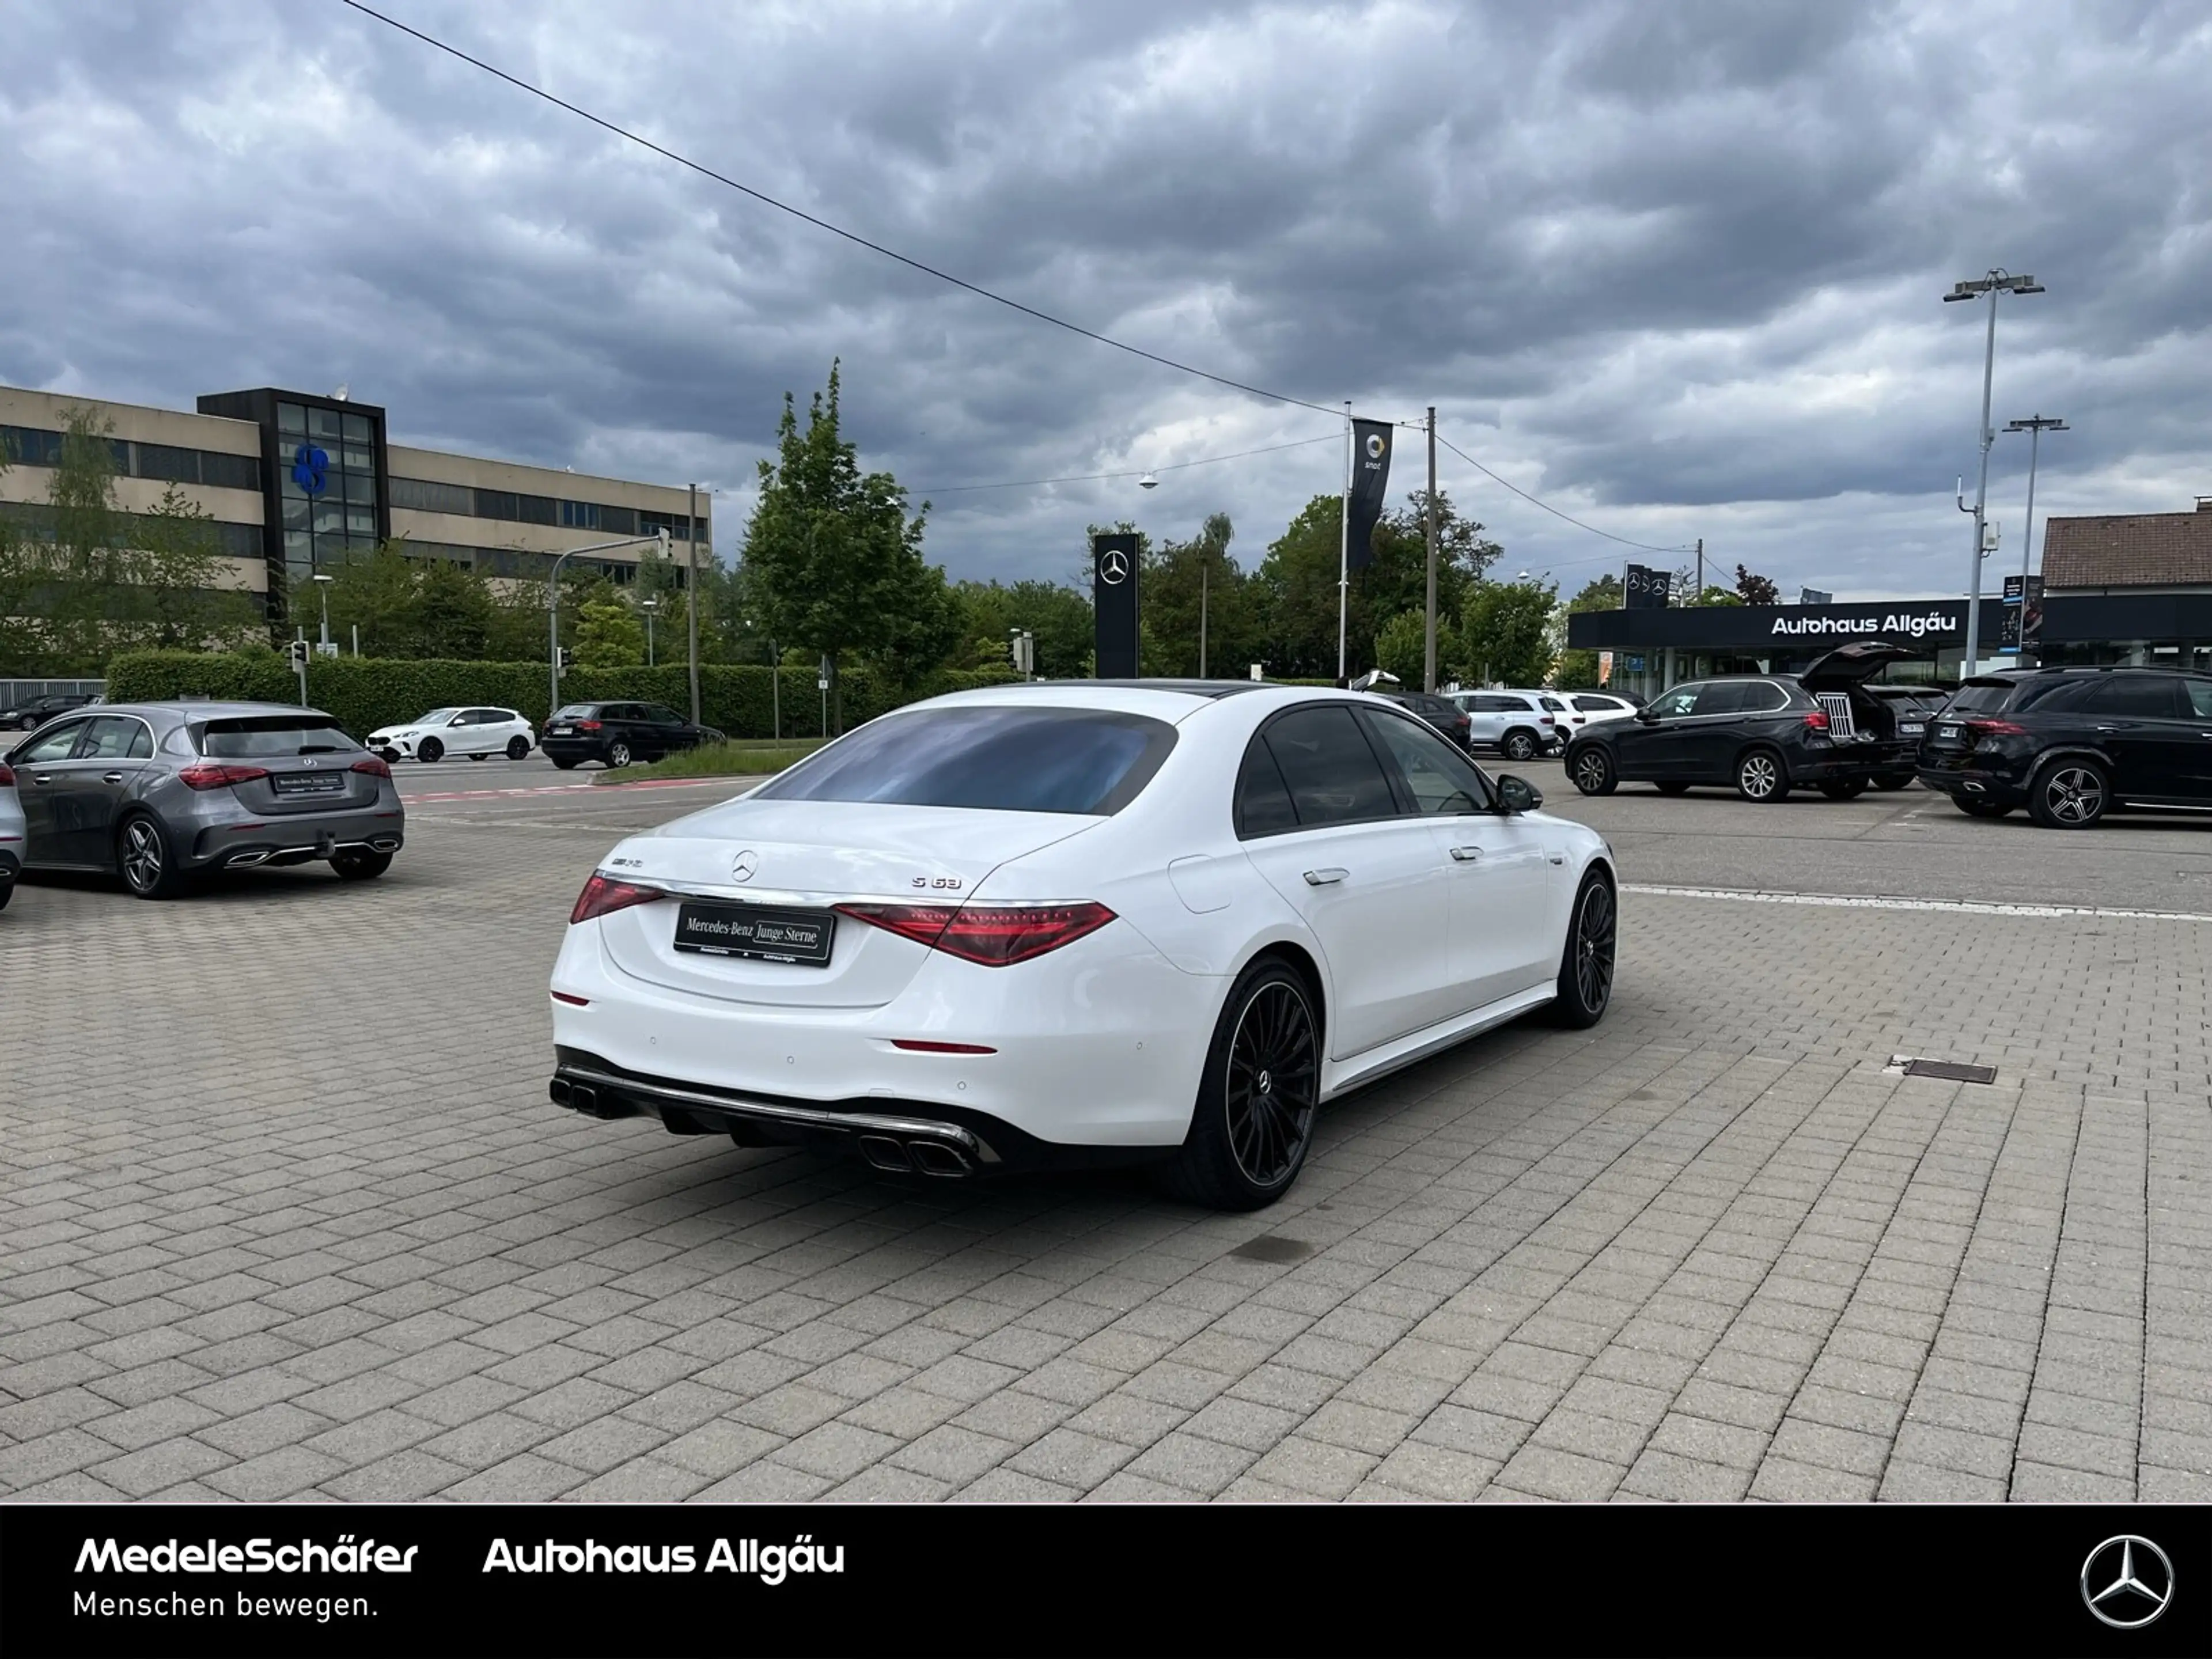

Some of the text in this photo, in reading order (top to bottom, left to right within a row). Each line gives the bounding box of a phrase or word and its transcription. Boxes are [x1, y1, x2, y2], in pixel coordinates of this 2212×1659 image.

[1771, 612, 1956, 637] Autohaus Allgäu
[912, 877, 961, 889] S 63
[686, 918, 817, 942] Mercedes-Benz Junge Sterne
